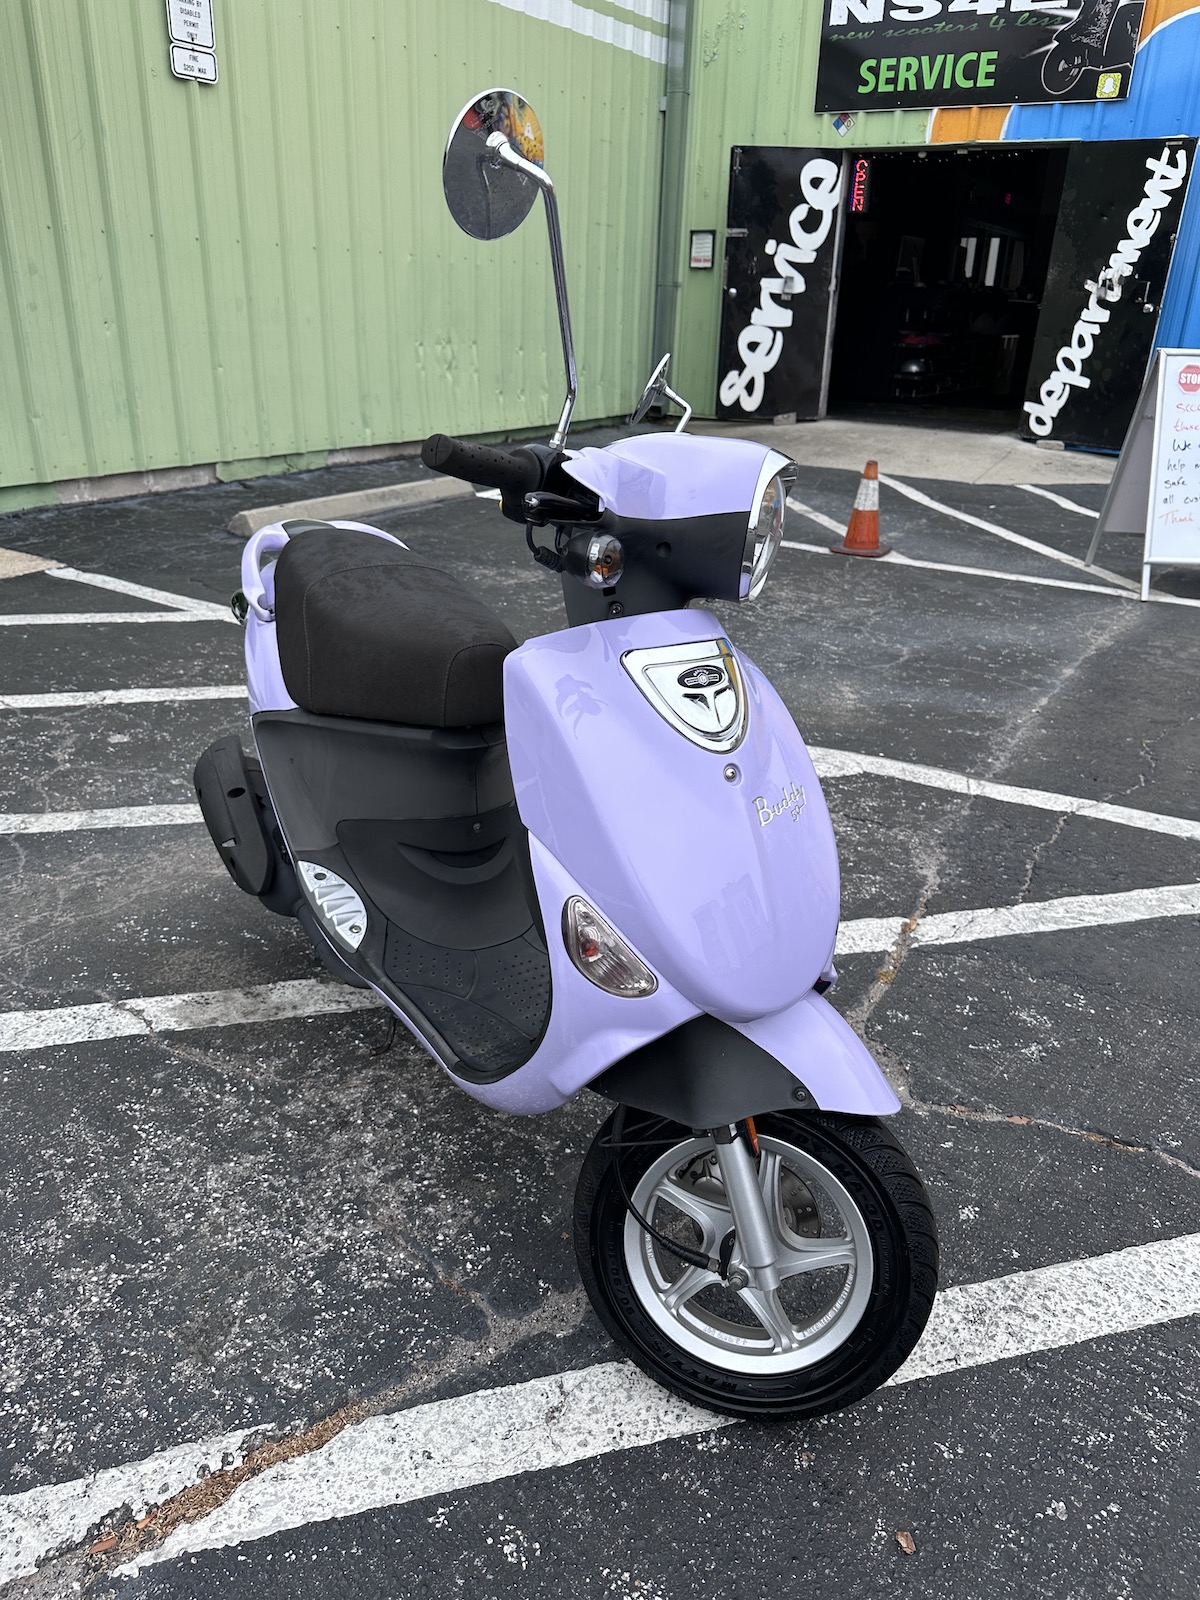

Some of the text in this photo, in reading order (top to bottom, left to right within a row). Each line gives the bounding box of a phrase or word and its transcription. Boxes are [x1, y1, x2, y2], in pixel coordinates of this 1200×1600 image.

[180, 7, 201, 18] DISABLED
[183, 20, 199, 29] PERMIT
[829, 12, 1064, 41] new scooters 4 less
[183, 63, 207, 75] $250 MAX
[189, 54, 199, 62] FINE
[858, 51, 998, 94] SERVICE
[719, 158, 843, 412] service
[1023, 147, 1187, 436] department
[1172, 438, 1191, 451] We
[1167, 458, 1186, 473] help
[752, 782, 806, 827] Buddy
[651, 1339, 737, 1392] MAXXIS
